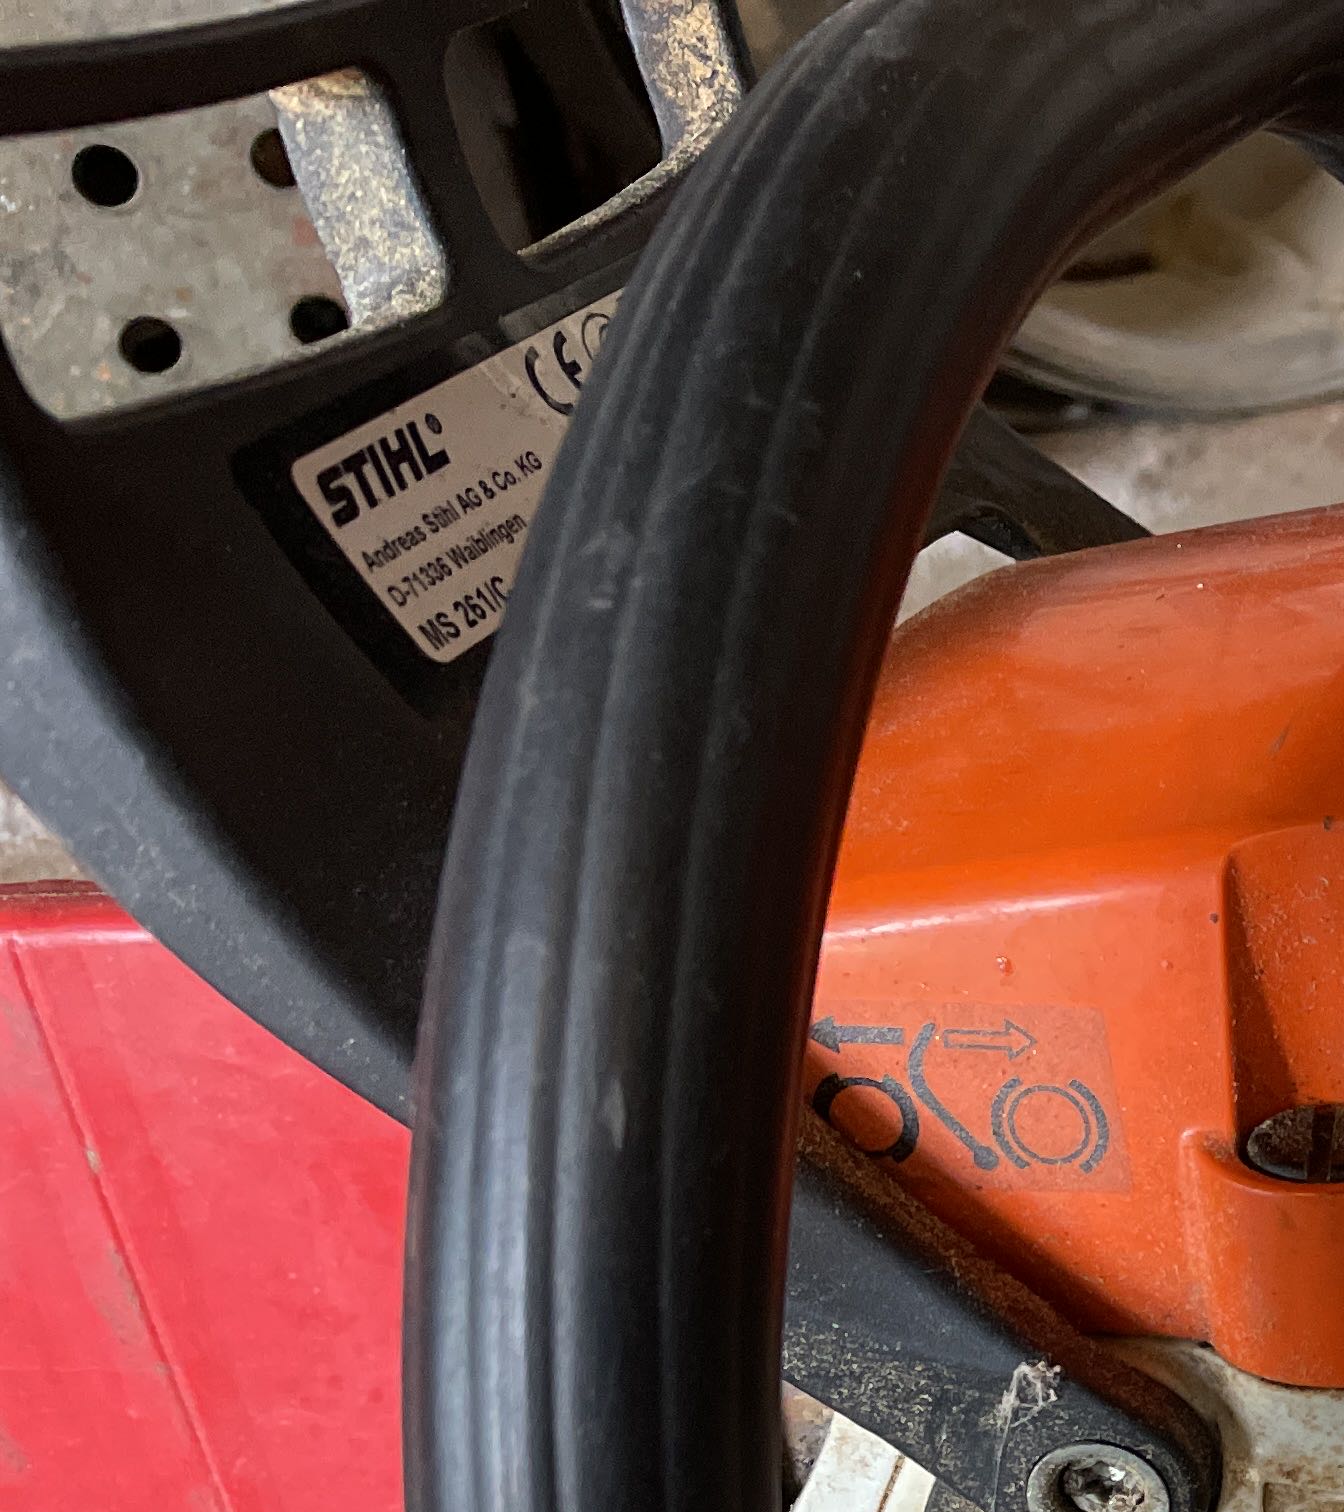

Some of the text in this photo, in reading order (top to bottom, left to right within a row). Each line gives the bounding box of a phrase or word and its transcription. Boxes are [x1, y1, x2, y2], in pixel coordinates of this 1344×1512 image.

[362, 525, 427, 573] Andreas
[456, 487, 483, 514] AG
[478, 479, 497, 500] &
[514, 450, 542, 477] KG
[387, 513, 528, 607] D-71336 Waiblingen
[417, 612, 461, 650] MS
